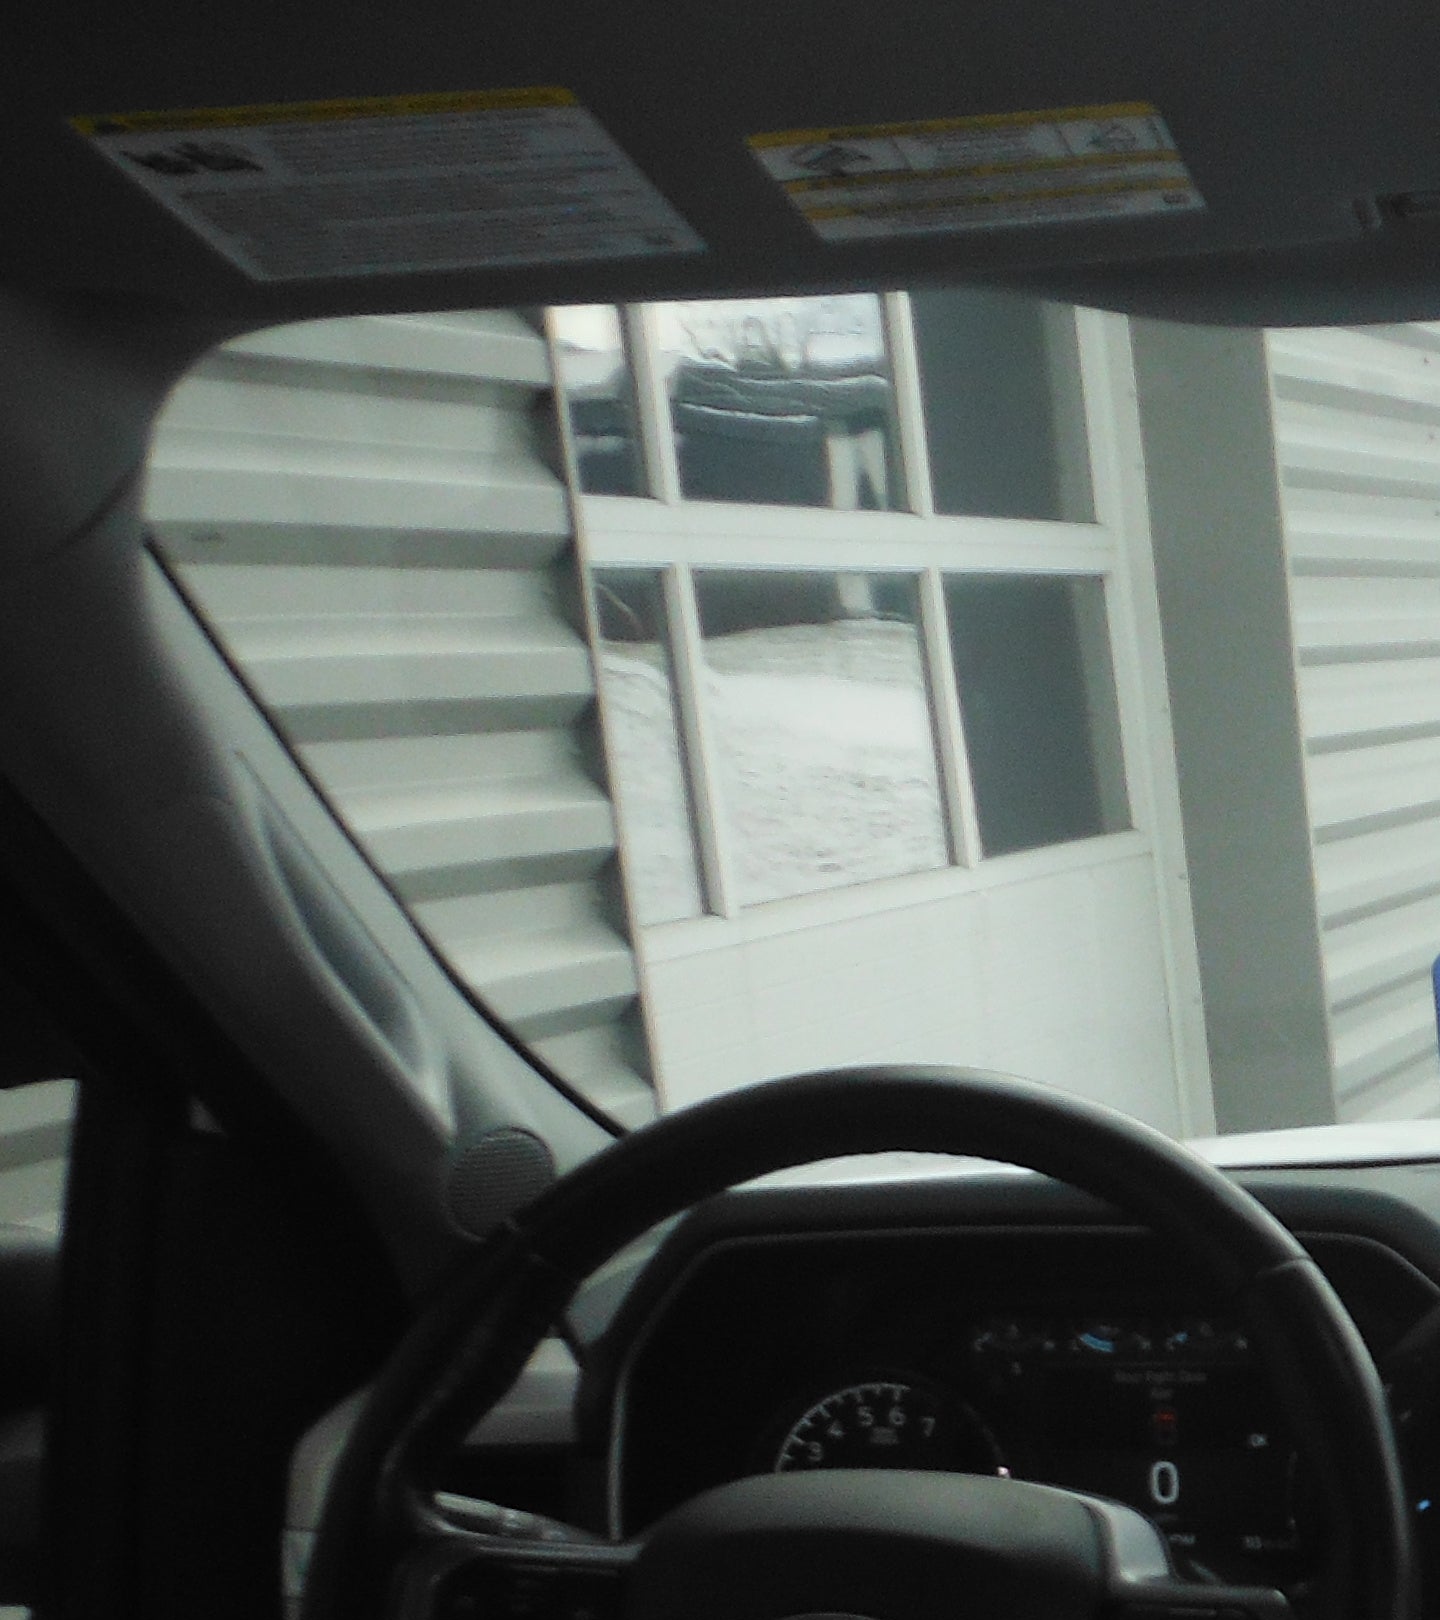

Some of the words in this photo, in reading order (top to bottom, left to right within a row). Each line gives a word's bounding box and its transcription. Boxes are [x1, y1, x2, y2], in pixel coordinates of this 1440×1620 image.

[857, 1406, 875, 1426] 5
[888, 1405, 907, 1426] 6
[919, 1416, 936, 1437] 7
[806, 1440, 824, 1462] 3
[1150, 1459, 1180, 1505] 0
